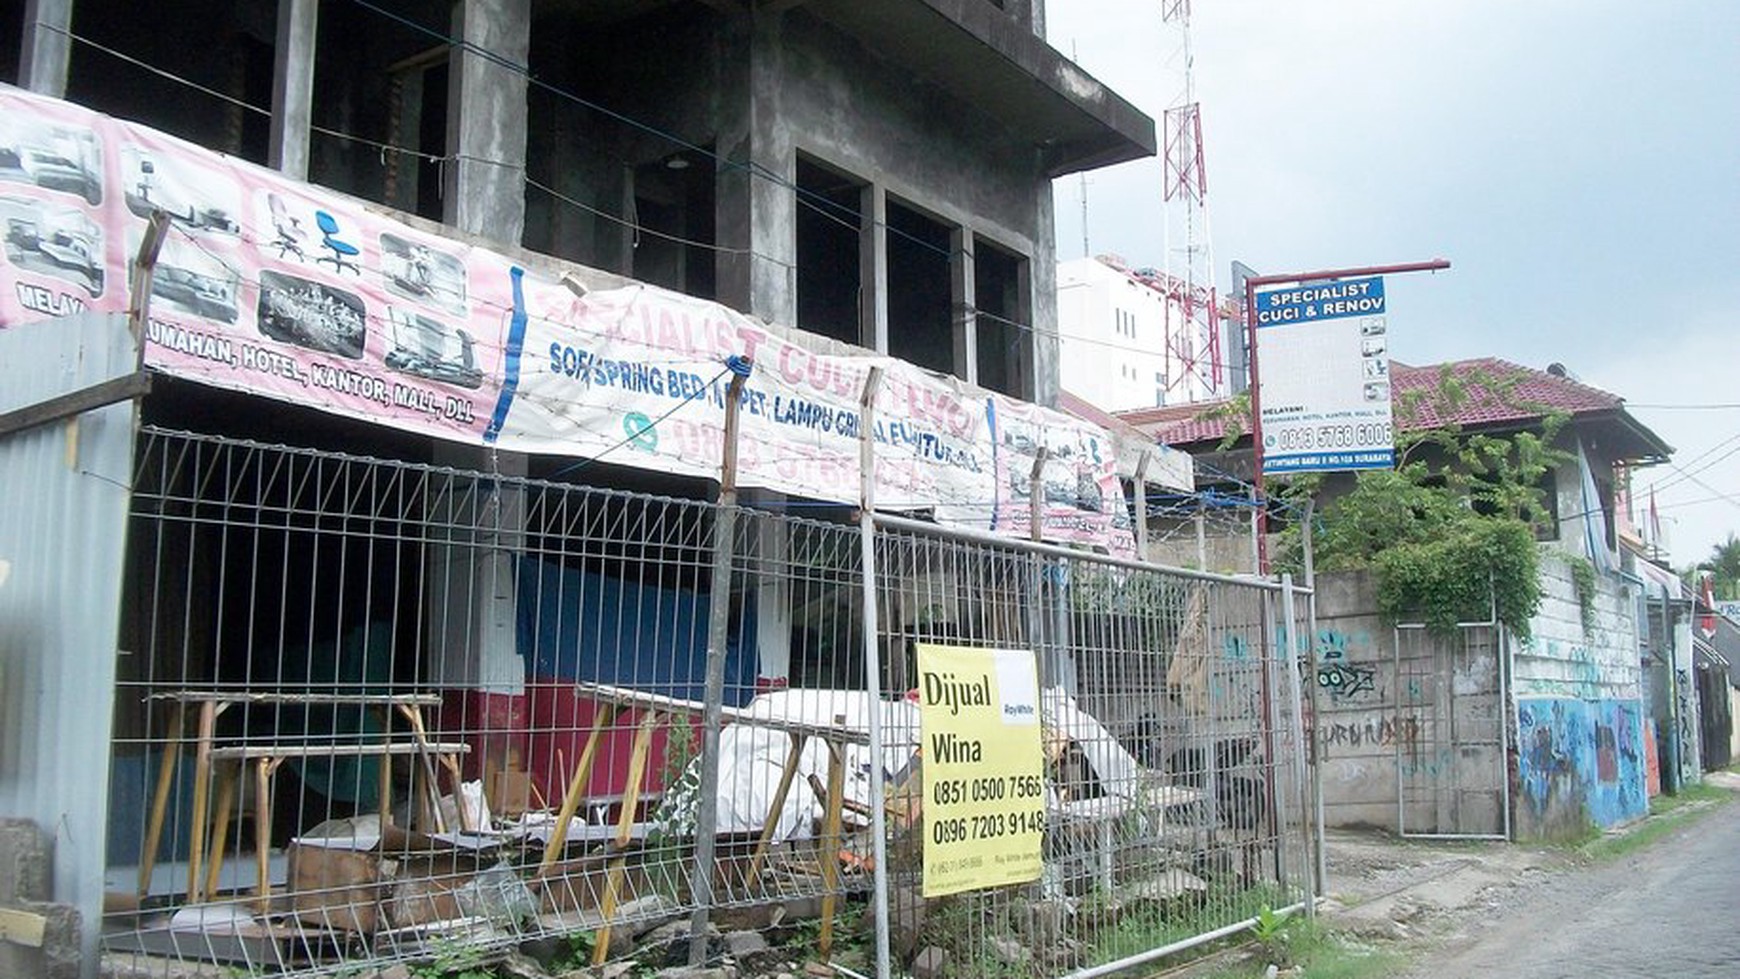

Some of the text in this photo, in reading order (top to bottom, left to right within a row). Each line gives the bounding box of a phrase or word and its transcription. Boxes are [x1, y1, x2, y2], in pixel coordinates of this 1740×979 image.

[16, 281, 88, 316] MELAY
[1259, 297, 1384, 323] CUCI & RENOV
[1270, 283, 1370, 306] SPECIALIST
[242, 344, 308, 388] HOTEL,
[311, 362, 390, 406] KANTOR,
[393, 382, 442, 421] MALL,
[444, 396, 475, 424] DLL
[1317, 424, 1353, 447] 5768
[1356, 421, 1392, 446] 6006
[923, 671, 992, 716] Dijual
[931, 733, 982, 764] Wina
[934, 779, 967, 805] 0851
[972, 777, 1005, 802] 0500
[933, 810, 1044, 845] 0896 7203 9148
